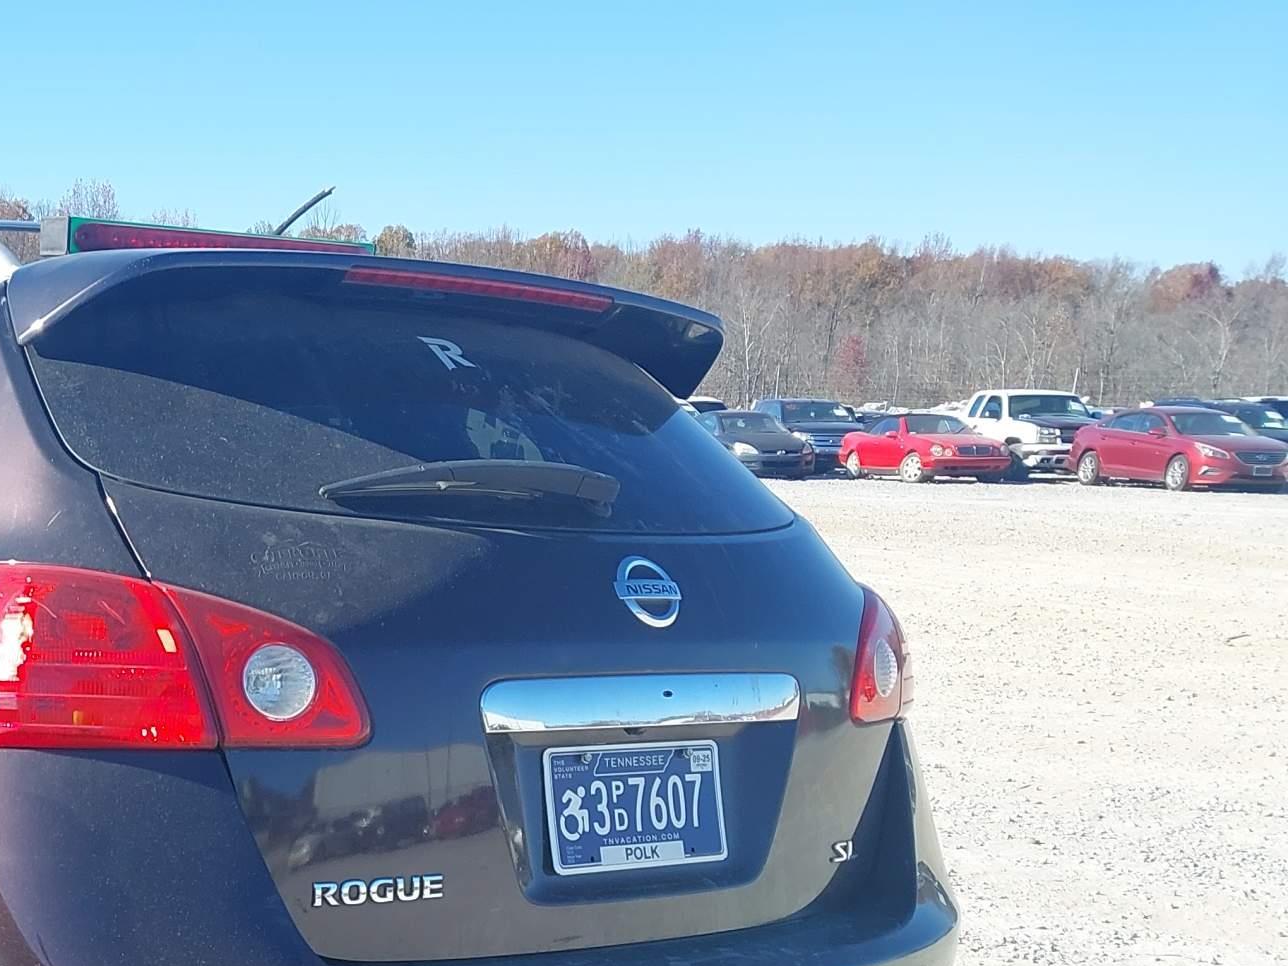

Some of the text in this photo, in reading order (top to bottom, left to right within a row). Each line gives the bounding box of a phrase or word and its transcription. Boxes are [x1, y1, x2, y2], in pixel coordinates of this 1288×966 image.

[416, 335, 477, 370] R
[626, 583, 678, 595] NISSAN
[604, 754, 665, 768] TENNESSEE
[603, 832, 680, 845] TNVACATION.COM
[625, 846, 661, 861] POLK
[312, 874, 444, 907] ROGUE
